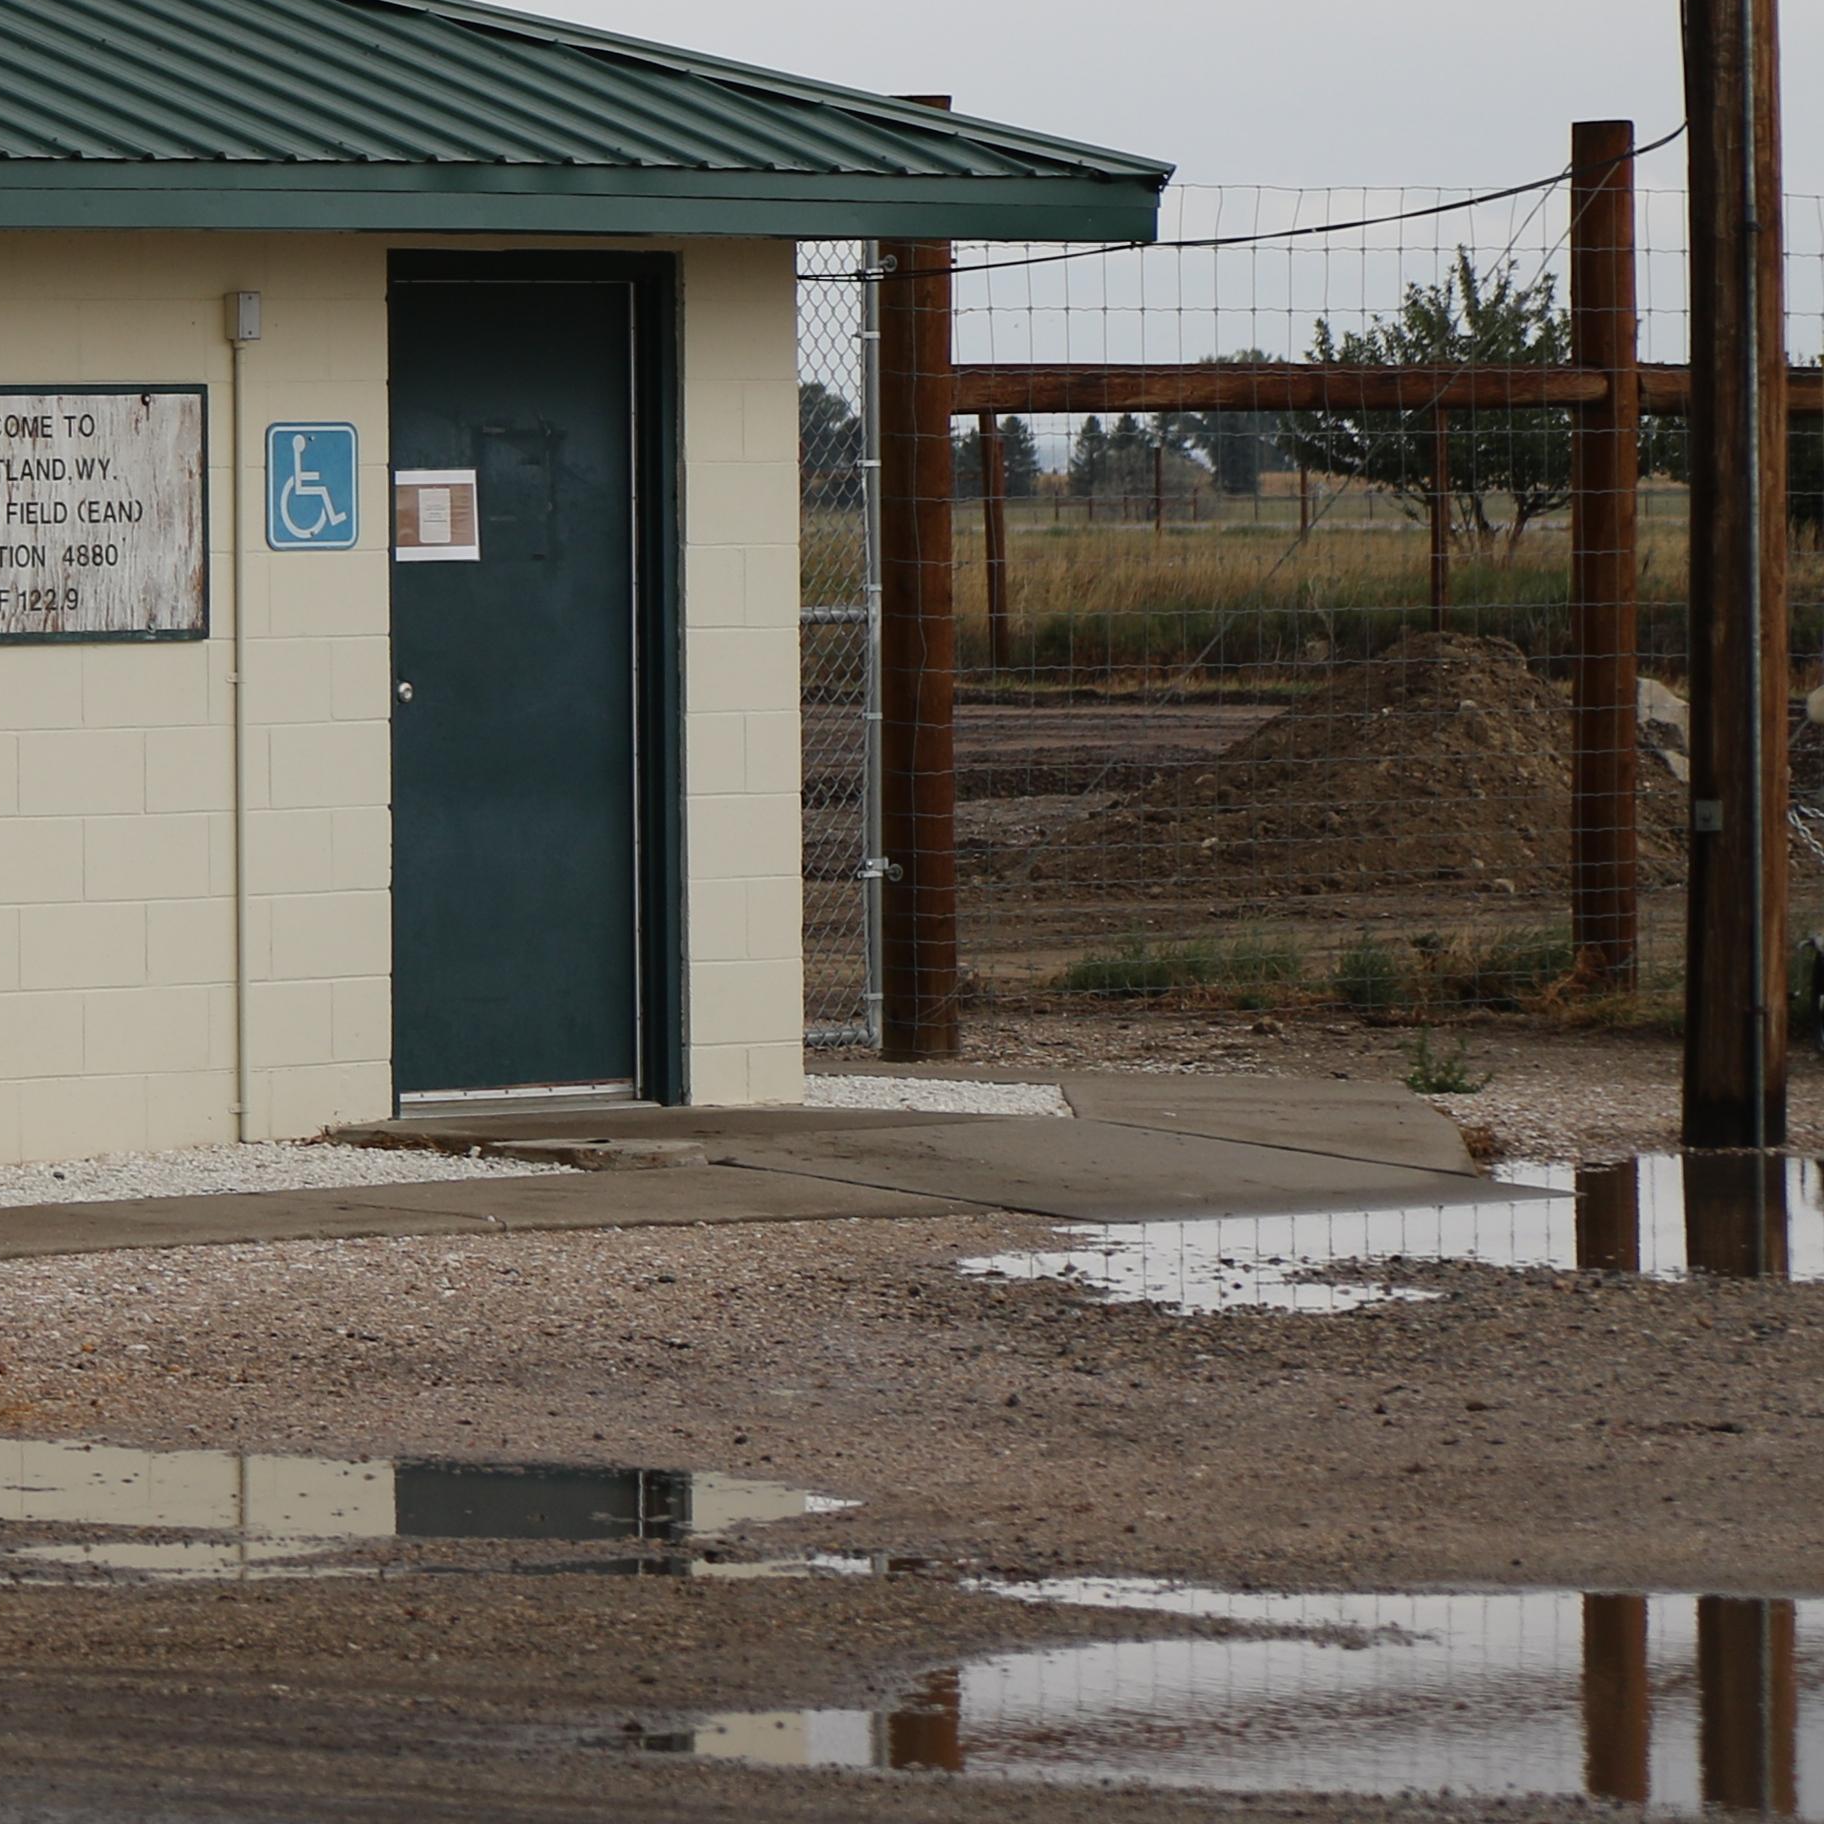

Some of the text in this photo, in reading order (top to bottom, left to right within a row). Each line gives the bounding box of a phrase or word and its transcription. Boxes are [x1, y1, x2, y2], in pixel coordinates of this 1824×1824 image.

[63, 414, 95, 437] TO
[7, 502, 67, 524] FIELD
[78, 500, 143, 523] (EAN)
[19, 588, 79, 612] 122.9
